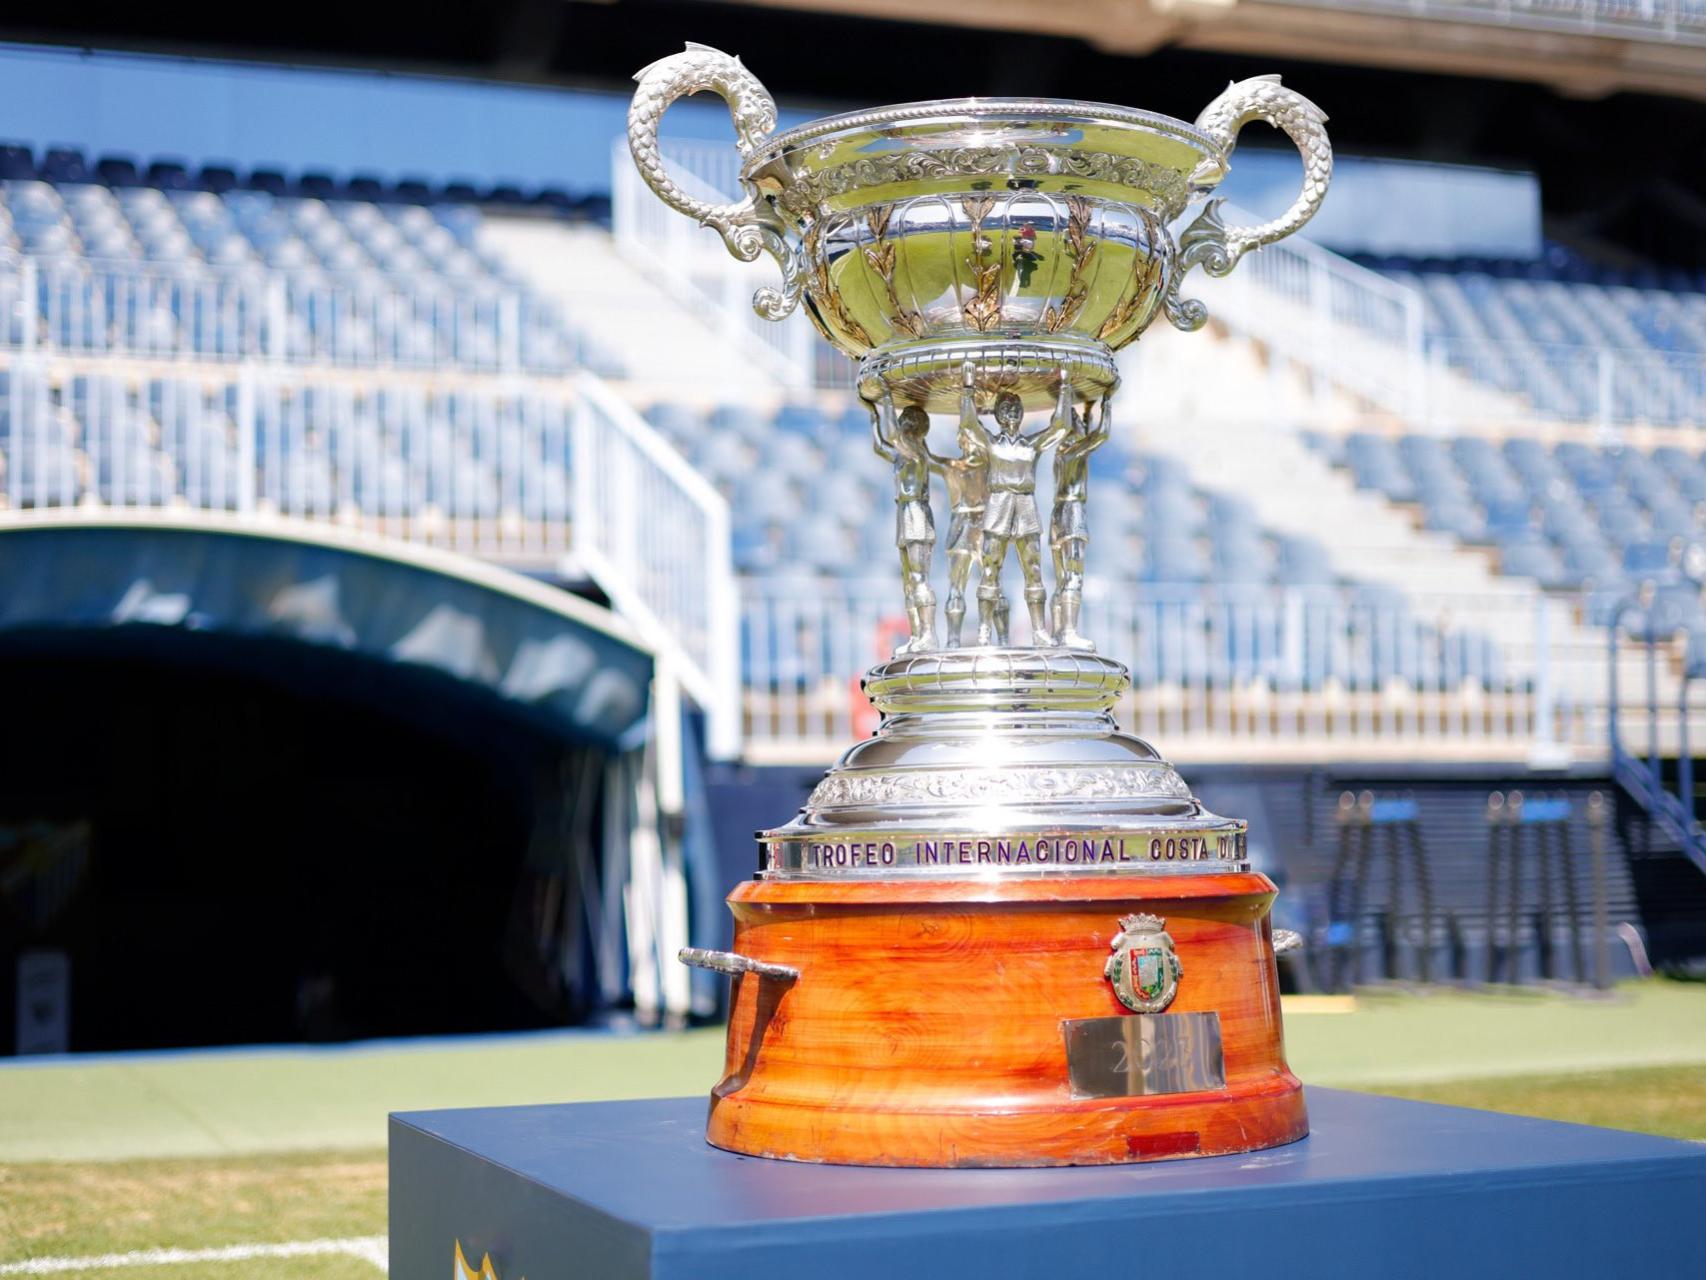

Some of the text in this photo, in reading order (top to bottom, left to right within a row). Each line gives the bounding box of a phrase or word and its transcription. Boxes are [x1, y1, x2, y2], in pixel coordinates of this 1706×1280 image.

[813, 842, 894, 868] TROFEO
[916, 839, 1131, 864] INTERNACIONAL
[1151, 837, 1209, 860] COSTA
